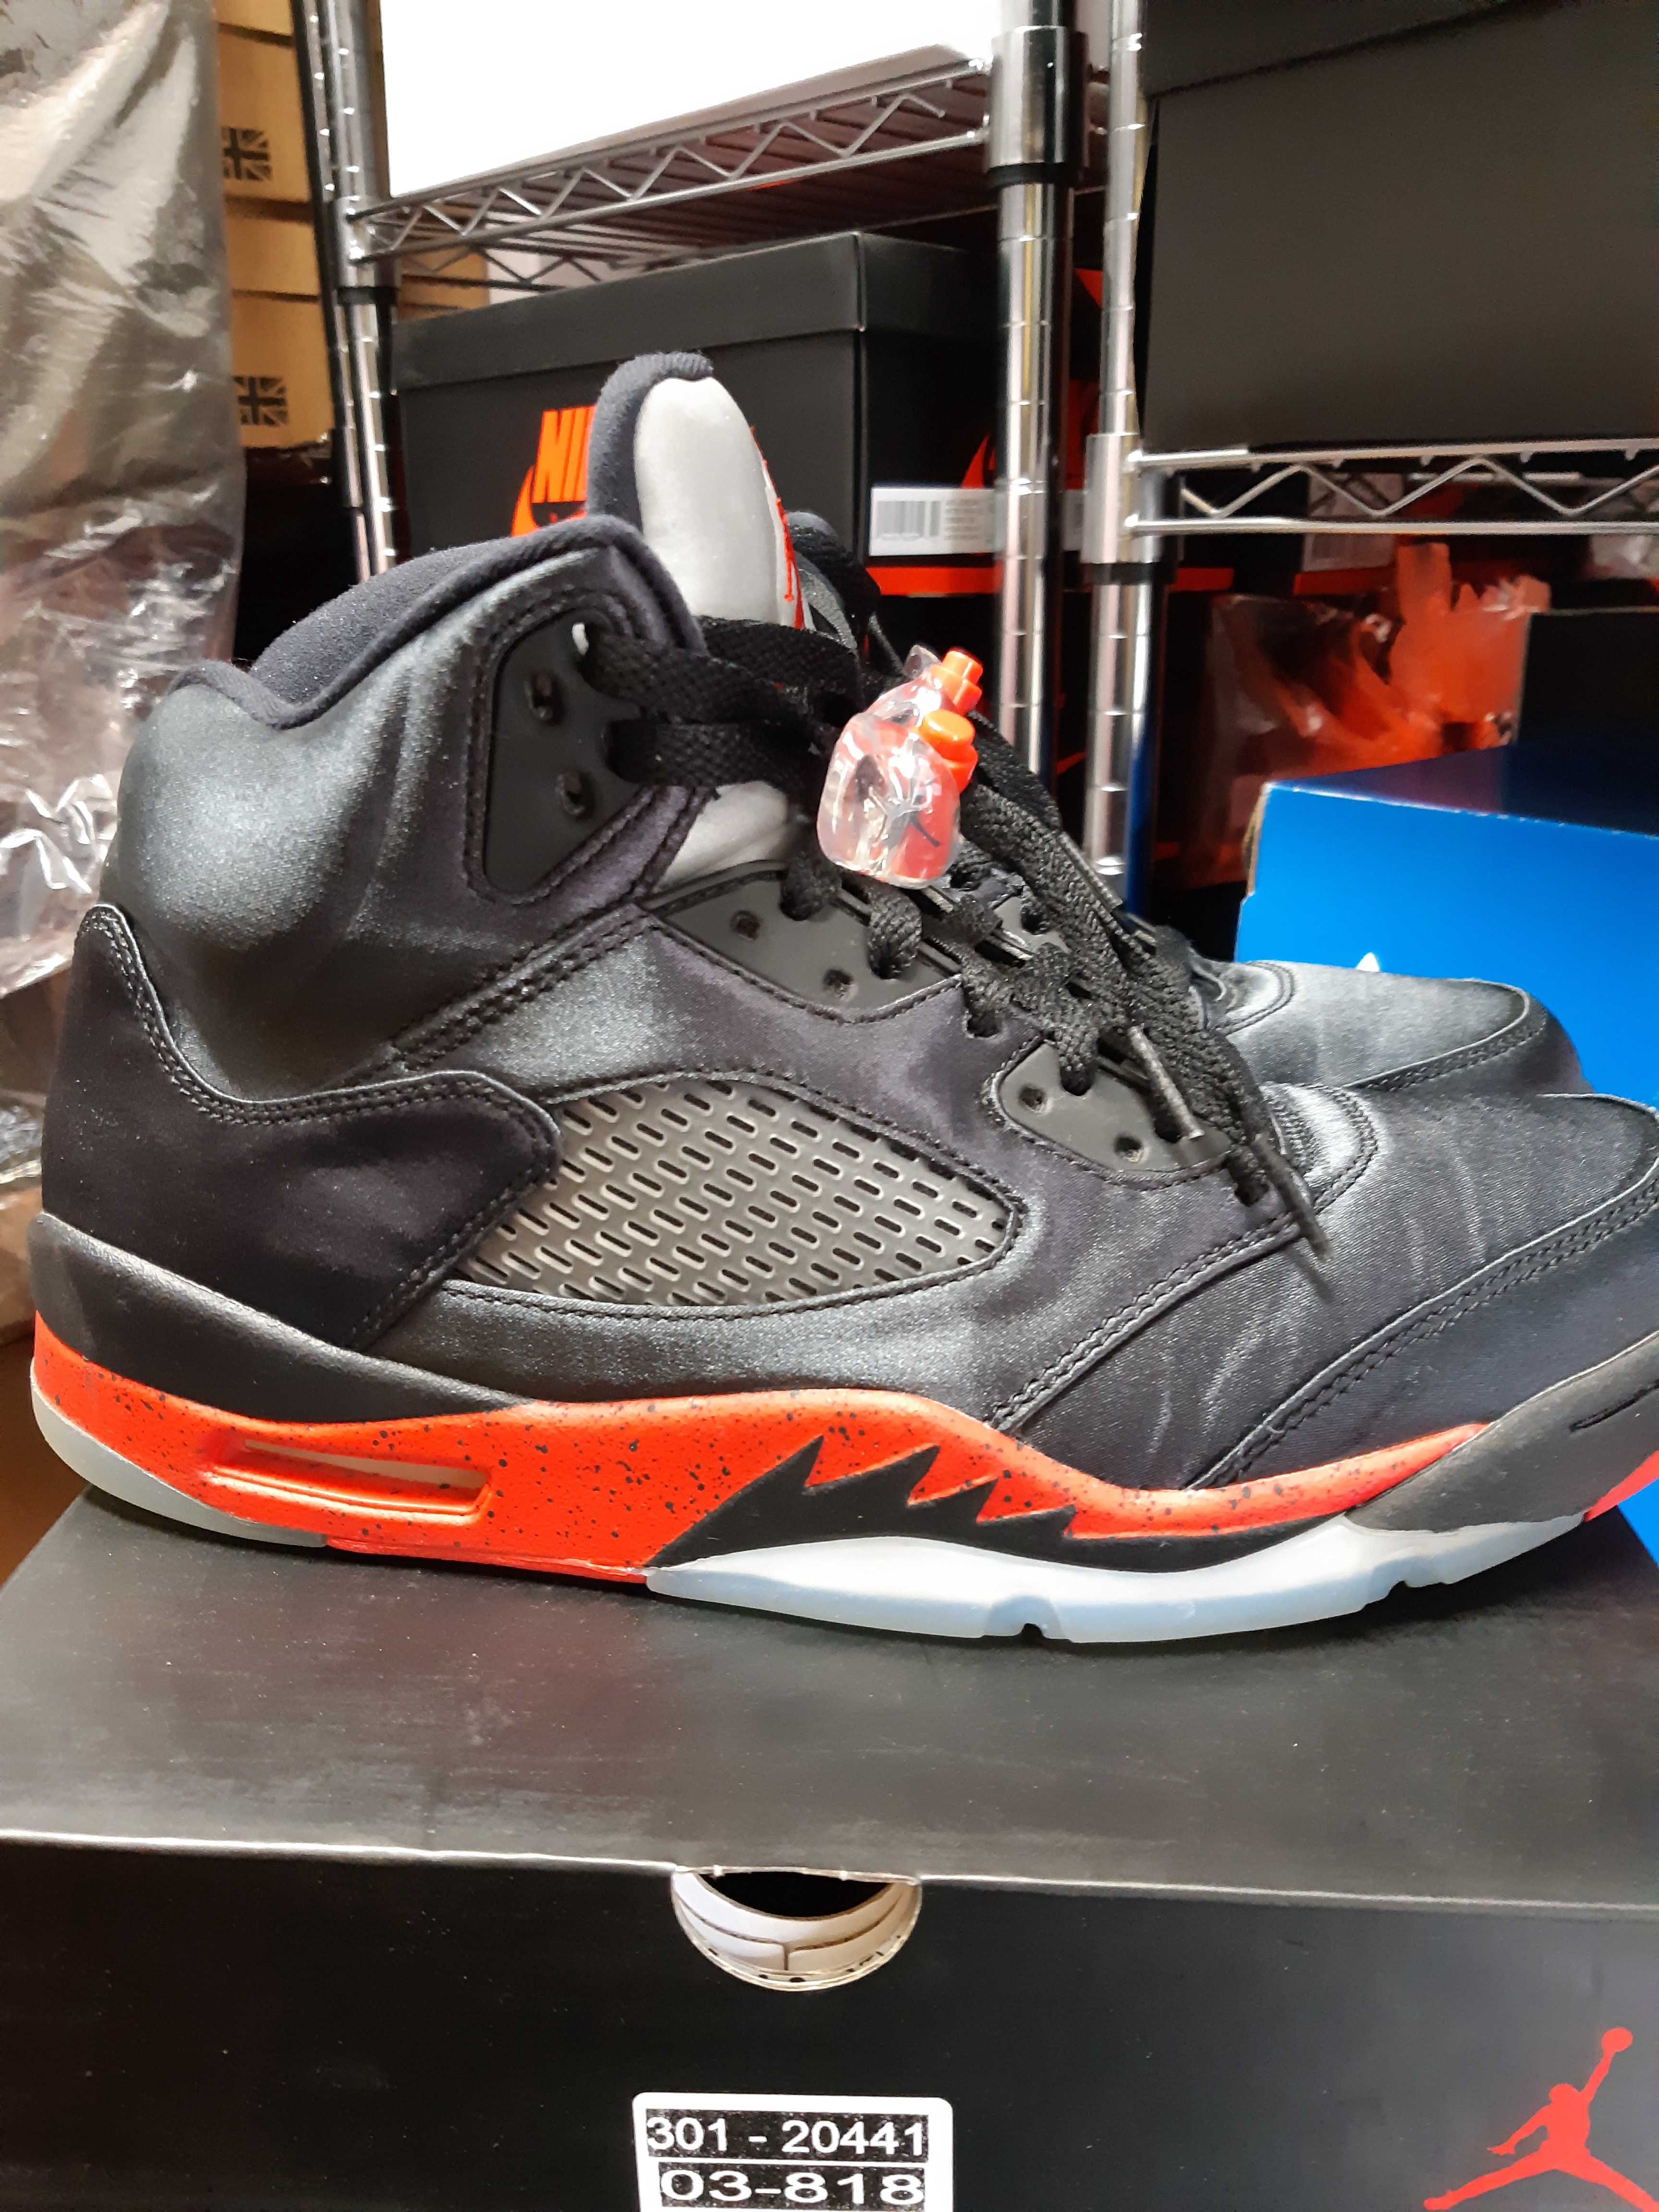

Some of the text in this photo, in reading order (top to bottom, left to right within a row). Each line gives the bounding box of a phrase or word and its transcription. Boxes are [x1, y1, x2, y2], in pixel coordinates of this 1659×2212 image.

[646, 2117, 728, 2151] 301
[781, 2120, 924, 2156] 20441
[661, 2169, 925, 2205] 03-818
